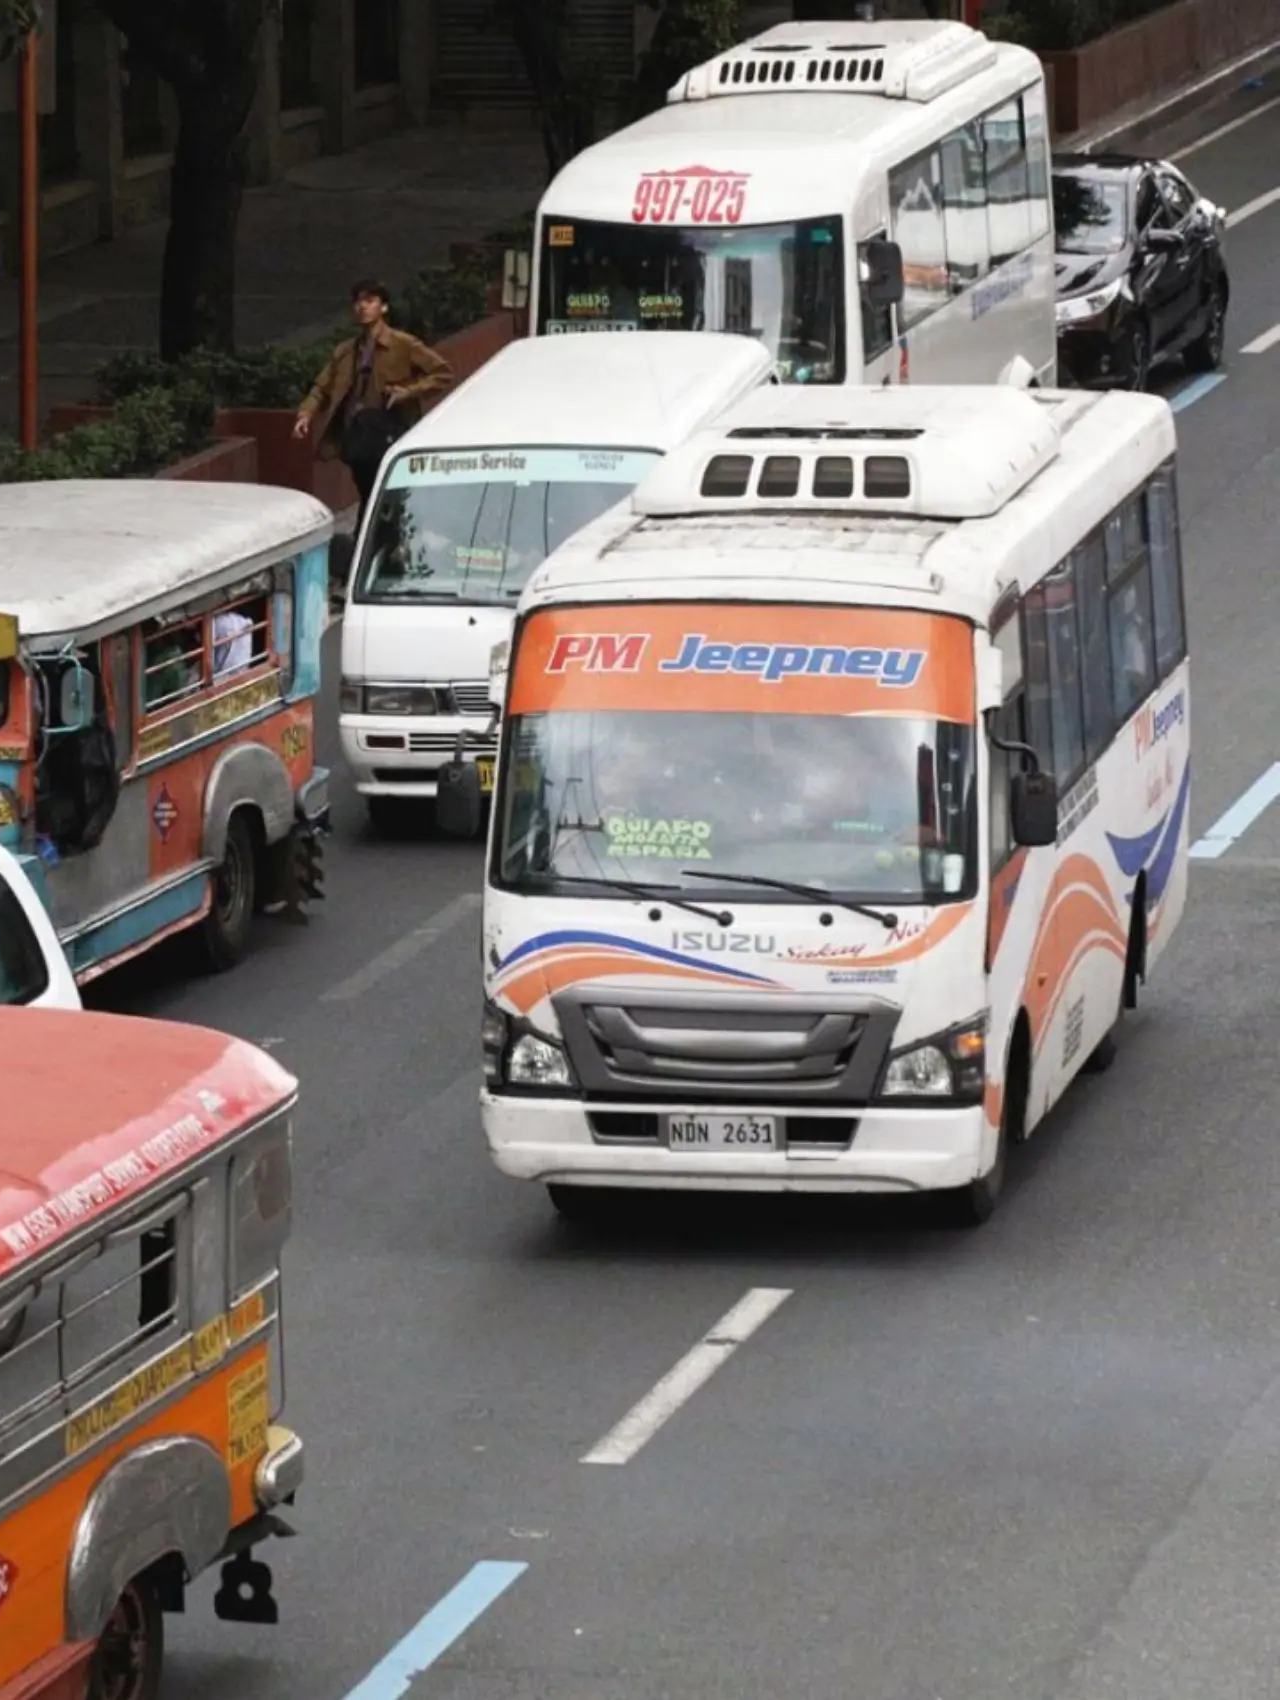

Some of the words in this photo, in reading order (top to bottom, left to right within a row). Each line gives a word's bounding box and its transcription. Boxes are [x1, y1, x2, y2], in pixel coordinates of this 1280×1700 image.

[631, 178, 749, 223] 997-025
[431, 455, 478, 476] Express
[480, 451, 527, 471] Service
[545, 633, 650, 673] PM
[658, 634, 928, 688] Jeepney
[608, 817, 711, 839] QUIAPO
[672, 931, 776, 954] ISUZU
[671, 1121, 710, 1143] NDN
[722, 1121, 773, 1144] 2631
